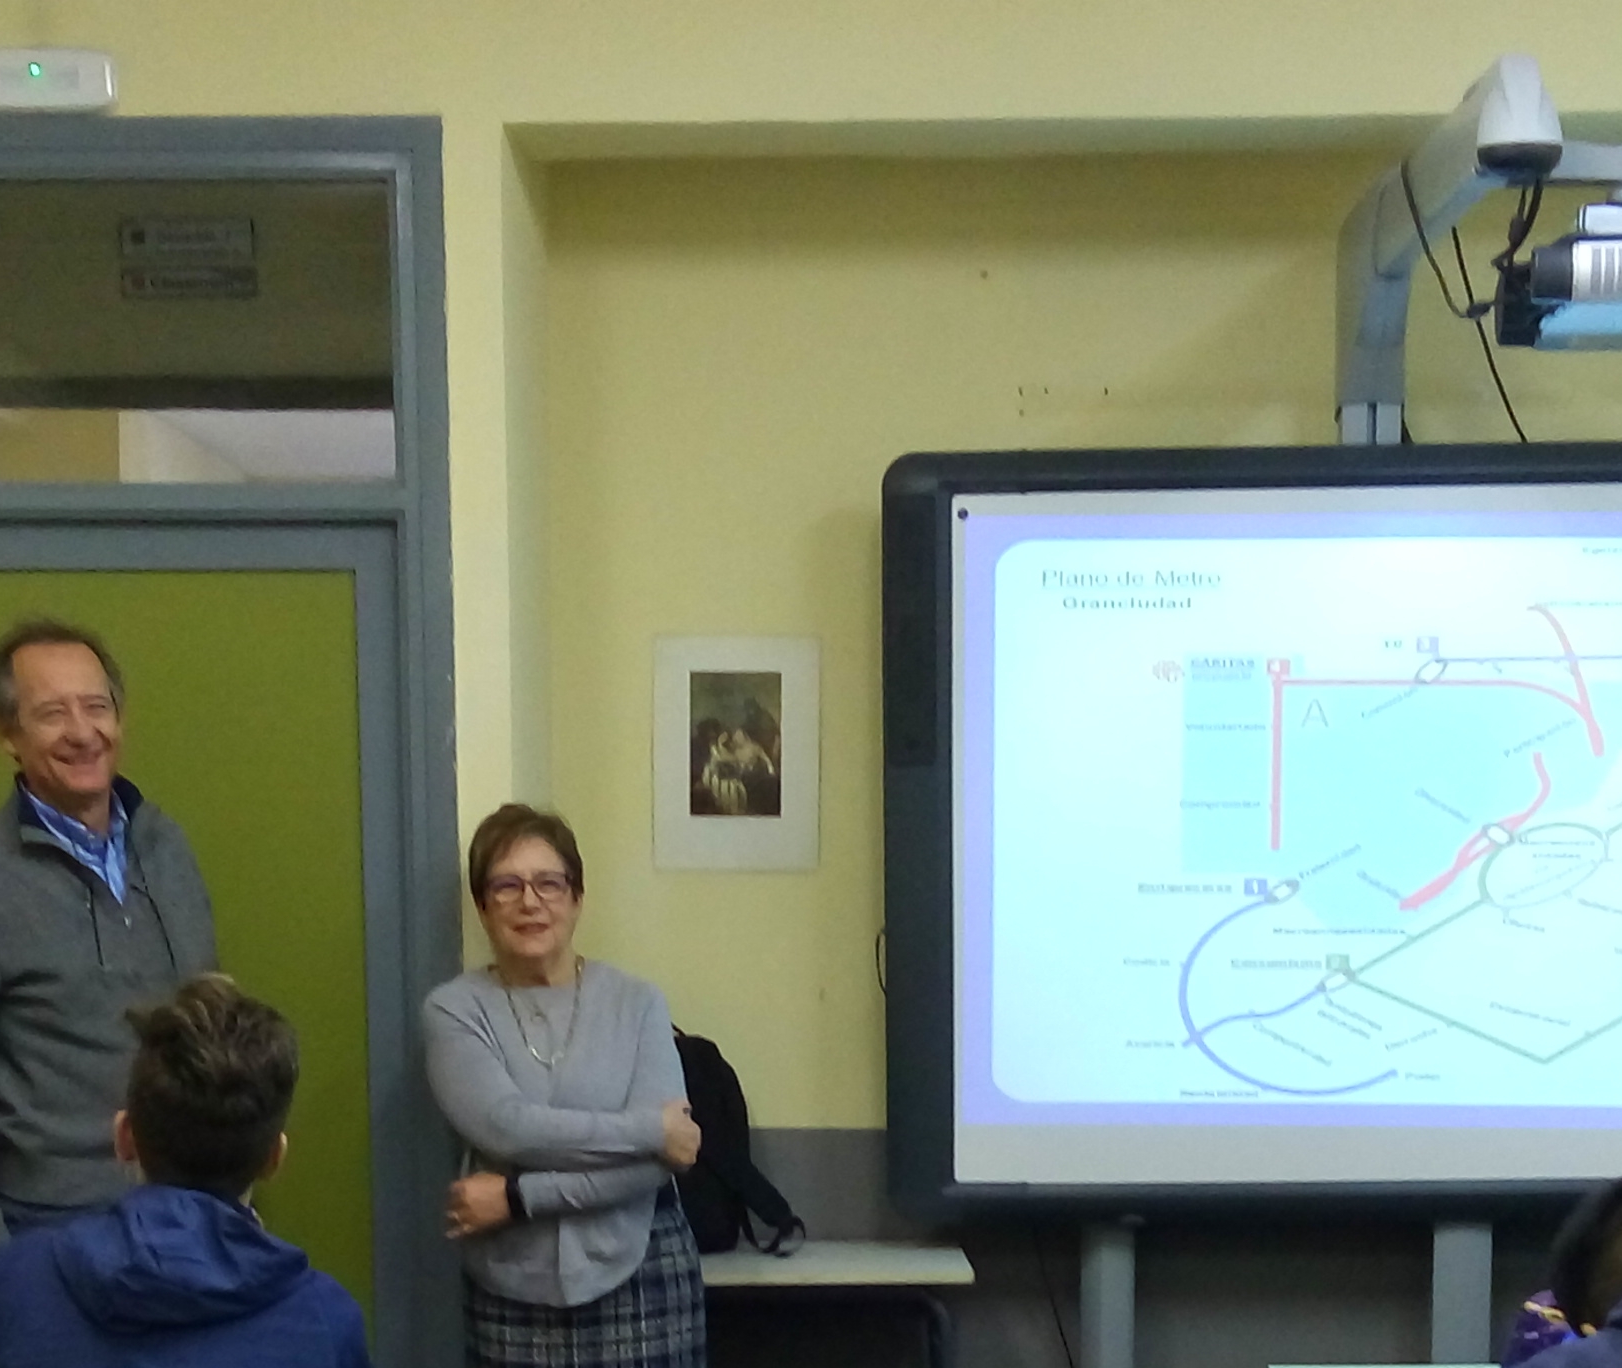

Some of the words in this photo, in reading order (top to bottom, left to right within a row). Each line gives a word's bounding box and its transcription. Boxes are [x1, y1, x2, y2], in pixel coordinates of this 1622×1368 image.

[1041, 569, 1109, 588] Plano
[1116, 570, 1145, 588] de
[1154, 569, 1222, 588] Metro
[1062, 596, 1192, 610] Granciudad
[1300, 697, 1330, 729] A
